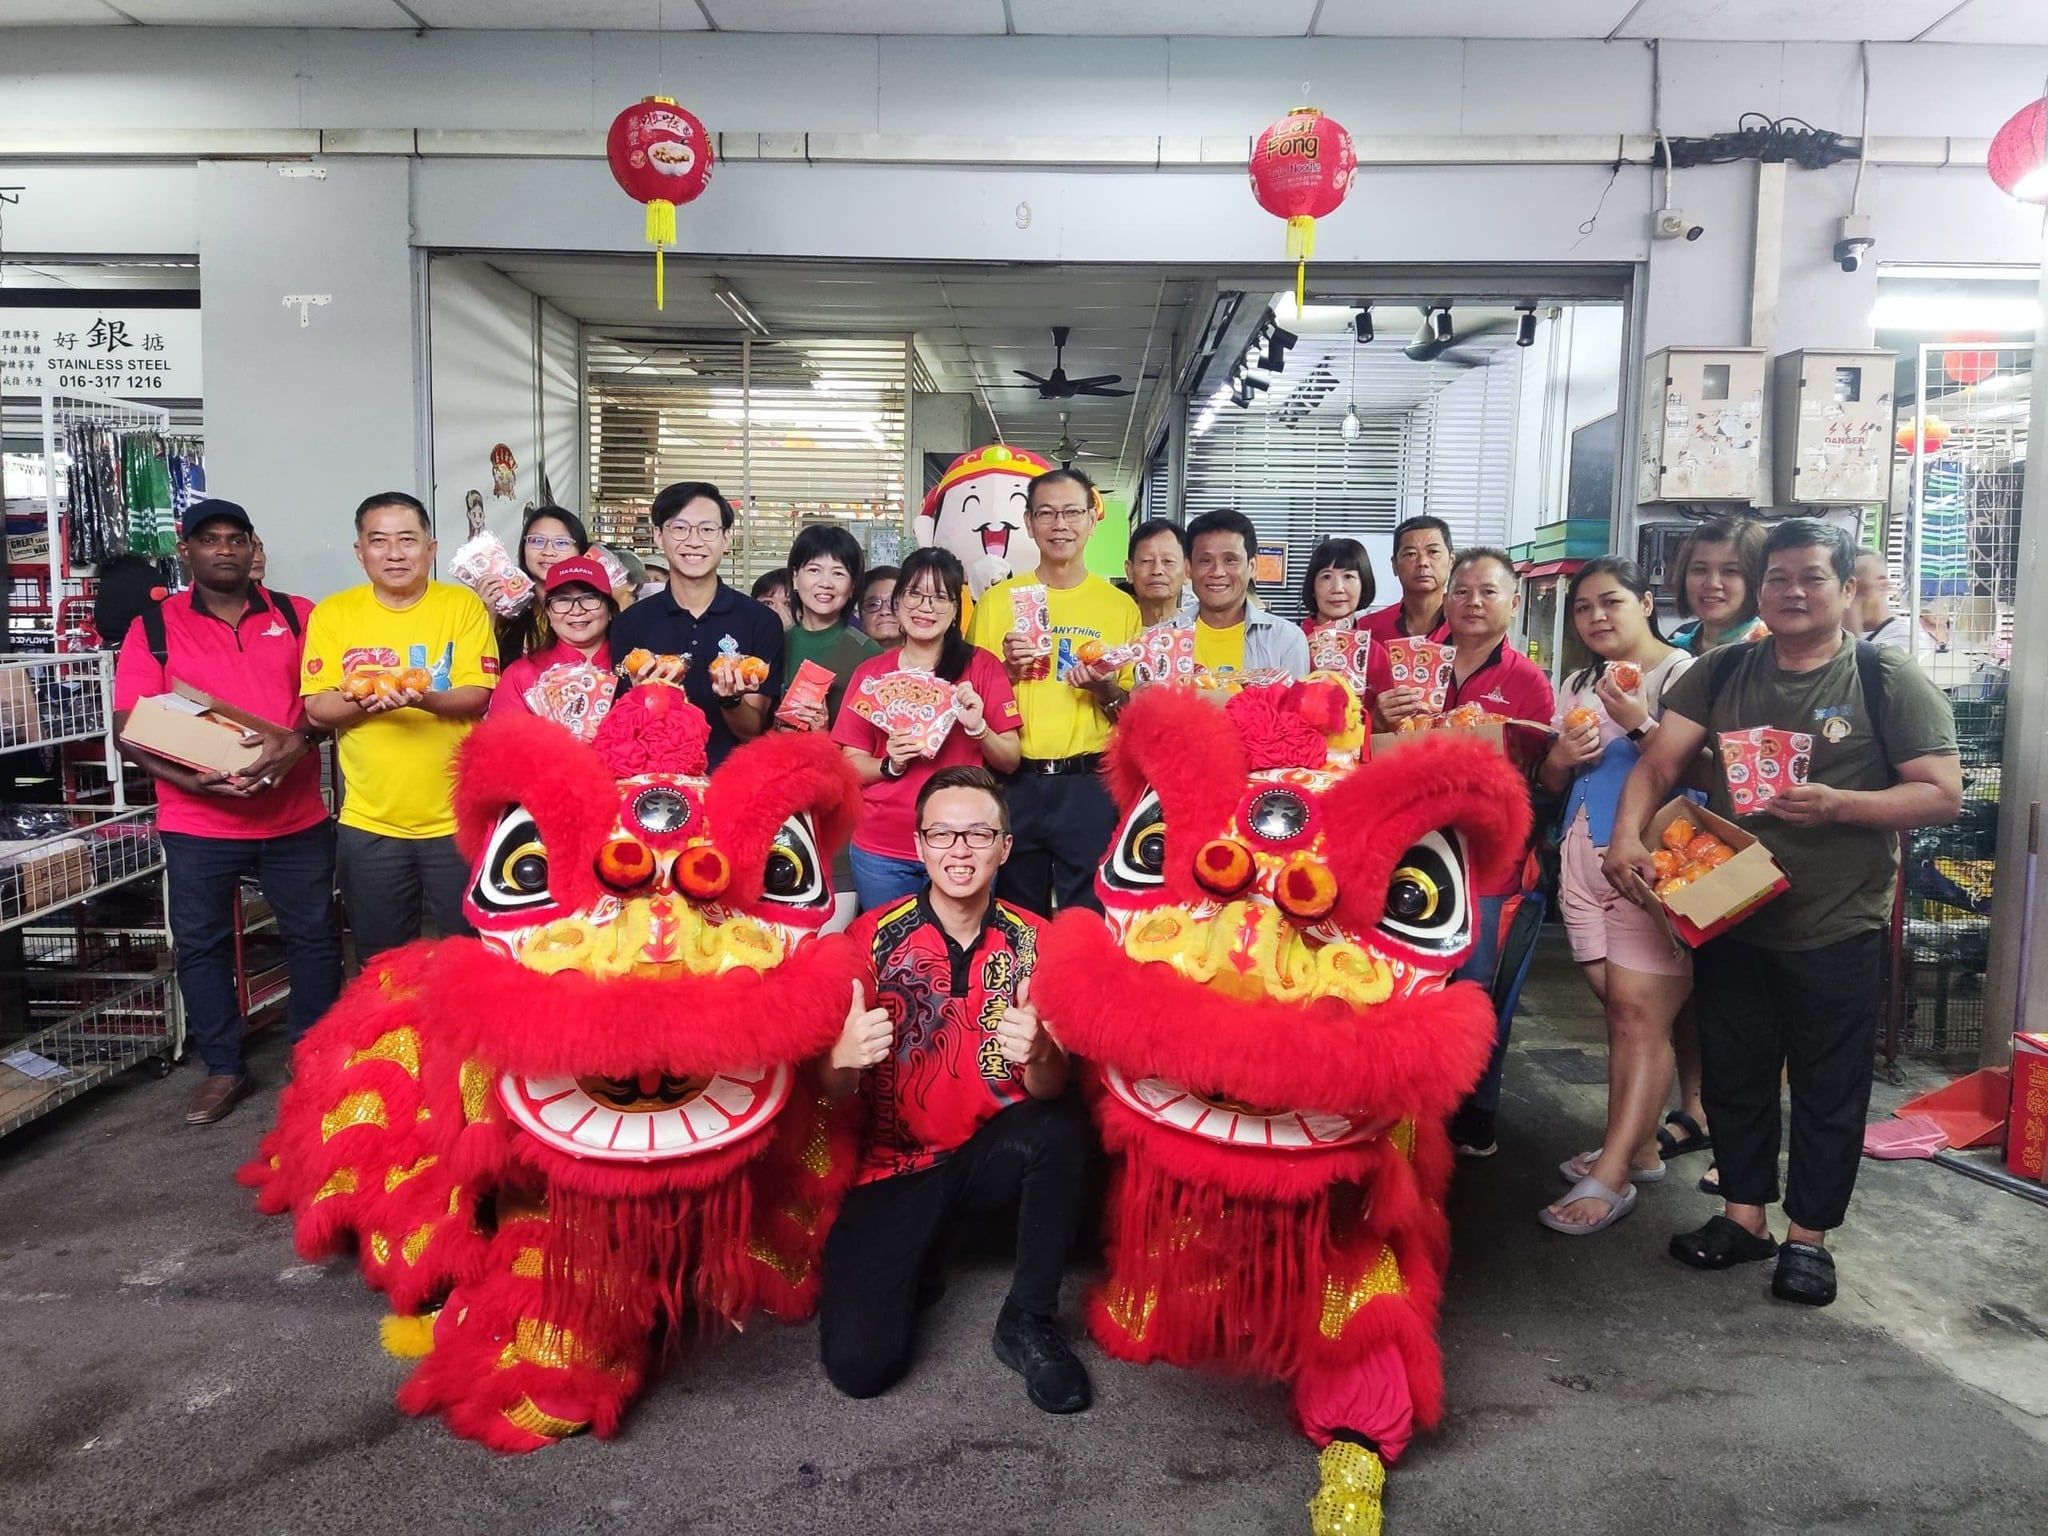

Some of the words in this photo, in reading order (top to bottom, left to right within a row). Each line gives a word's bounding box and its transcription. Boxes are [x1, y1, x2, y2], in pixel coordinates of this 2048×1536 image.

[1267, 136, 1318, 161] Fong
[1289, 161, 1321, 173] Noodle
[1015, 200, 1032, 230] 9
[48, 359, 123, 370] STAINLESS
[128, 360, 171, 370] STEEL
[60, 375, 120, 388] 016-317
[127, 376, 162, 388] 1216
[1825, 436, 1865, 444] DANGER
[1052, 626, 1101, 639] ANYTHING
